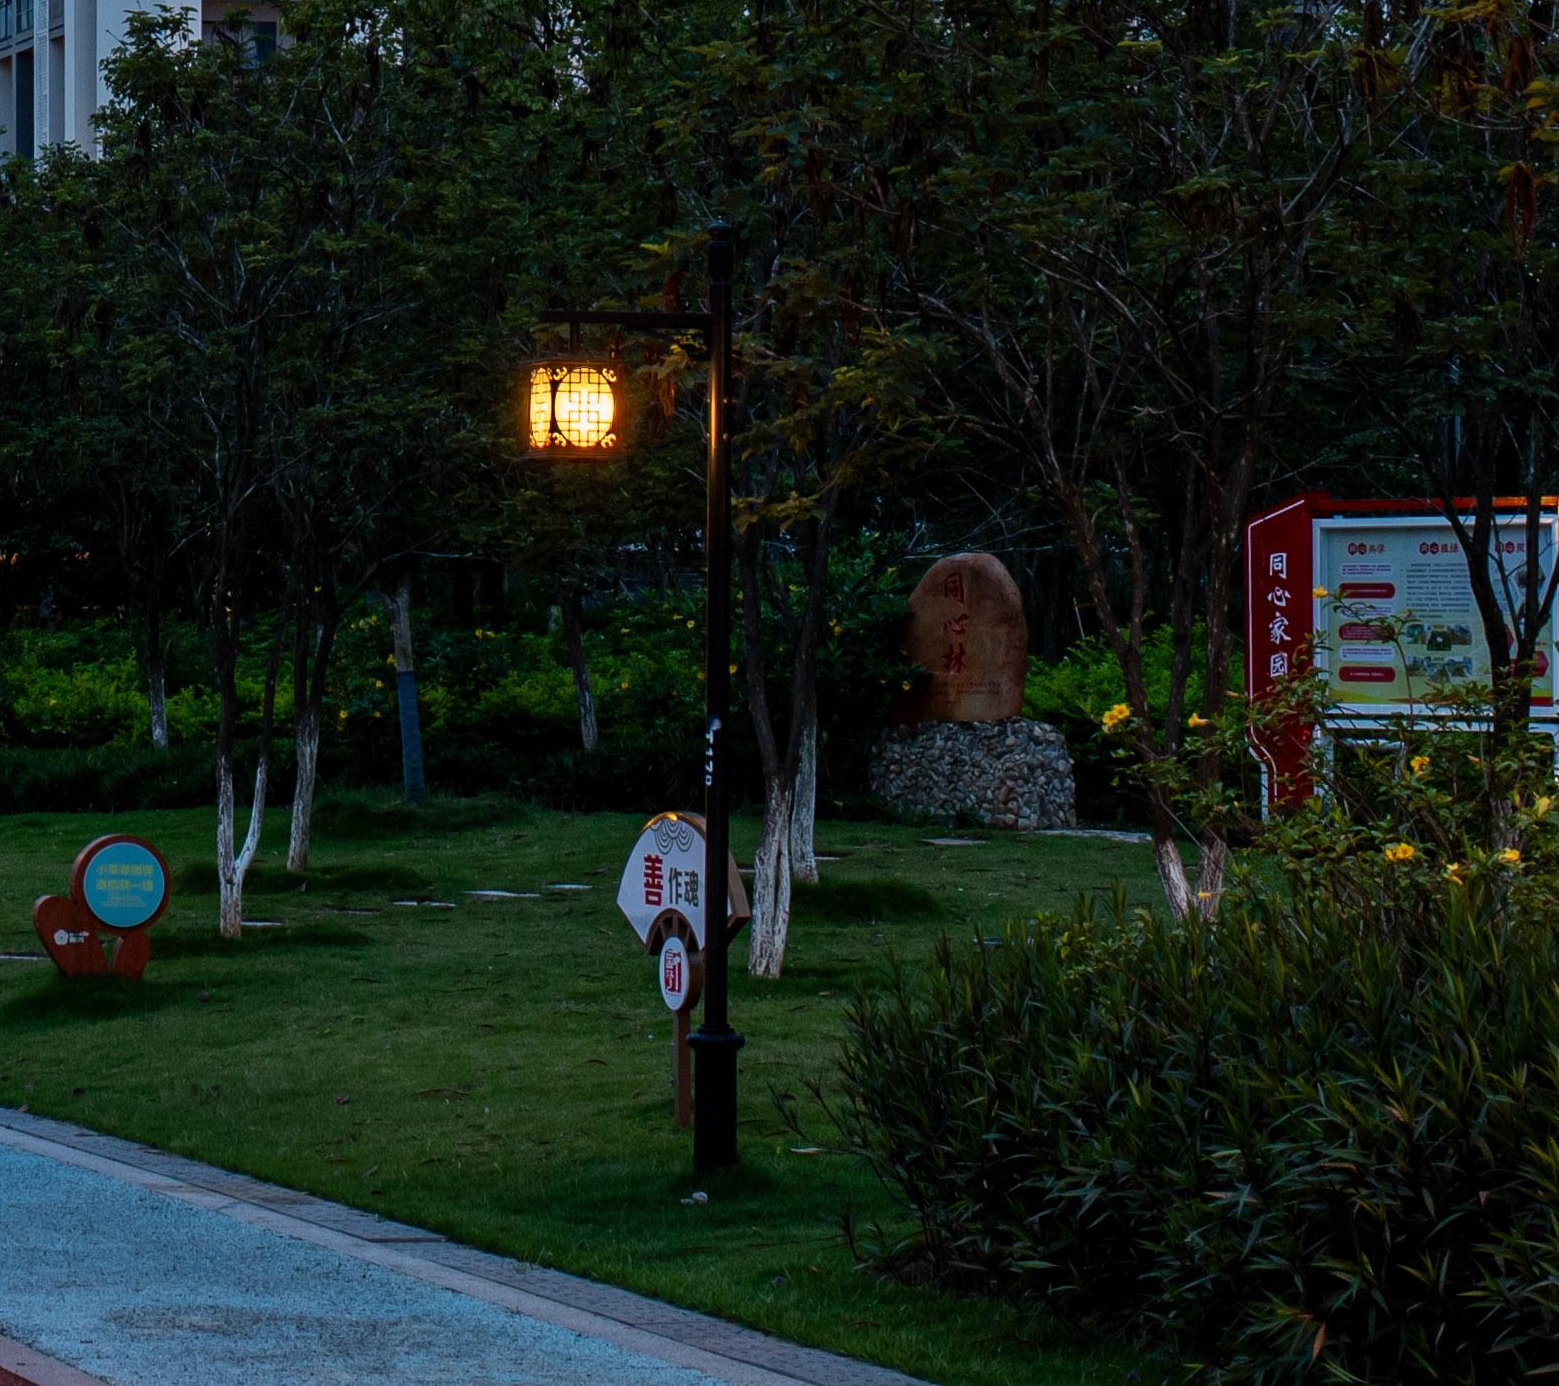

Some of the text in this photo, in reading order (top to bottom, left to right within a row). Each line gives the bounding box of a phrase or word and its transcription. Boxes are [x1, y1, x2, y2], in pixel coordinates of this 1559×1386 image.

[942, 571, 968, 674] 同心林
[1267, 552, 1292, 678] 同心家园
[643, 853, 699, 908] 善作魂
